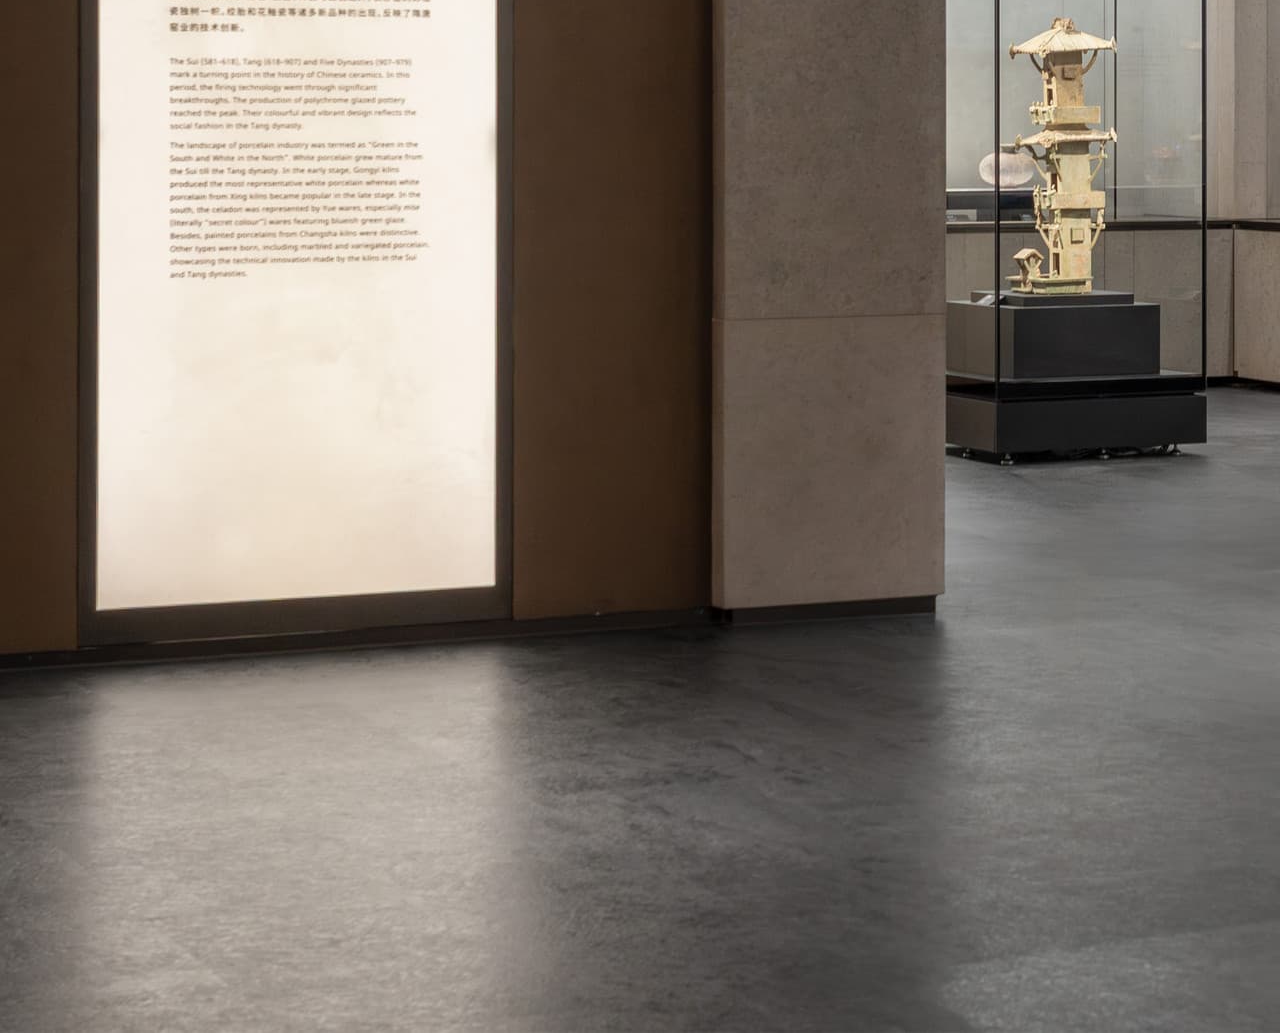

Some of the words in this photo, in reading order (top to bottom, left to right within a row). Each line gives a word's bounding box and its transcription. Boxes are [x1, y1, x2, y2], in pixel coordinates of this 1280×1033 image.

[170, 56, 184, 65] The
[186, 56, 198, 65] Sui
[243, 57, 262, 67] Tang
[303, 57, 318, 66] and
[320, 58, 335, 66] Five
[337, 58, 373, 68] Dynasties
[170, 69, 190, 78] mark
[199, 70, 229, 80] turning
[231, 70, 251, 80] point
[263, 70, 275, 78] the
[277, 70, 304, 80] history
[317, 70, 347, 79] Chinese
[396, 71, 409, 79] this
[199, 82, 213, 91] the
[215, 82, 236, 93] firing
[238, 82, 281, 93] technology
[284, 82, 302, 91] went
[305, 82, 336, 93] through
[338, 82, 377, 93] significant
[232, 96, 247, 104] The
[249, 96, 292, 106] production
[304, 96, 349, 106] polychrome
[351, 96, 376, 106] glazed
[378, 96, 406, 106] pottery
[170, 109, 202, 117] reached
[204, 108, 217, 117] the
[242, 108, 262, 117] Their
[264, 108, 299, 117] colourful
[301, 108, 316, 116] and
[347, 108, 372, 118] design
[404, 108, 416, 116] the
[170, 122, 192, 130] social
[194, 121, 224, 130] fashion
[235, 121, 249, 130] the
[251, 121, 270, 131] Tang
[170, 141, 184, 149] The
[186, 140, 226, 151] landscape
[239, 140, 275, 150] porcelain
[277, 140, 309, 150] industry
[327, 140, 356, 148] termed
[406, 139, 418, 148] the
[170, 154, 193, 162] South
[195, 153, 210, 162] and
[212, 153, 235, 162] White
[246, 153, 259, 162] the
[292, 153, 315, 161] White
[317, 153, 352, 163] porcelain
[355, 154, 373, 163] grew
[375, 153, 403, 161] mature
[405, 152, 423, 161] from
[170, 167, 183, 175] the
[185, 167, 197, 175] Sui
[211, 166, 225, 175] the
[227, 166, 246, 176] Tang
[292, 166, 305, 174] the
[307, 166, 326, 176] early
[382, 166, 399, 174] kilns
[170, 180, 208, 190] produced
[210, 179, 222, 188] the
[225, 179, 245, 188] most
[305, 178, 325, 187] white
[328, 178, 363, 188] porcelain
[399, 177, 419, 186] white
[170, 193, 207, 203] porcelain
[209, 192, 228, 201] from
[249, 192, 267, 200] kilns
[269, 192, 299, 200] became
[343, 191, 355, 199] the
[358, 191, 372, 199] late
[409, 190, 420, 199] the
[196, 205, 210, 214] the
[262, 204, 309, 214] represented
[364, 203, 402, 213] especially
[293, 216, 329, 227] featuring
[361, 218, 383, 226] green
[204, 231, 234, 241] painted
[279, 230, 297, 238] from
[339, 229, 357, 238] kilns
[170, 244, 192, 252] Other
[195, 243, 216, 254] types
[262, 242, 298, 252] including
[335, 241, 349, 250] and
[170, 257, 216, 267] showcasing
[218, 256, 231, 264] the
[313, 255, 334, 263] made
[347, 254, 360, 262] the
[362, 254, 379, 262] kilns
[391, 253, 403, 262] the
[405, 253, 417, 262] Sui
[170, 270, 185, 278] and
[187, 269, 206, 280] Tang
